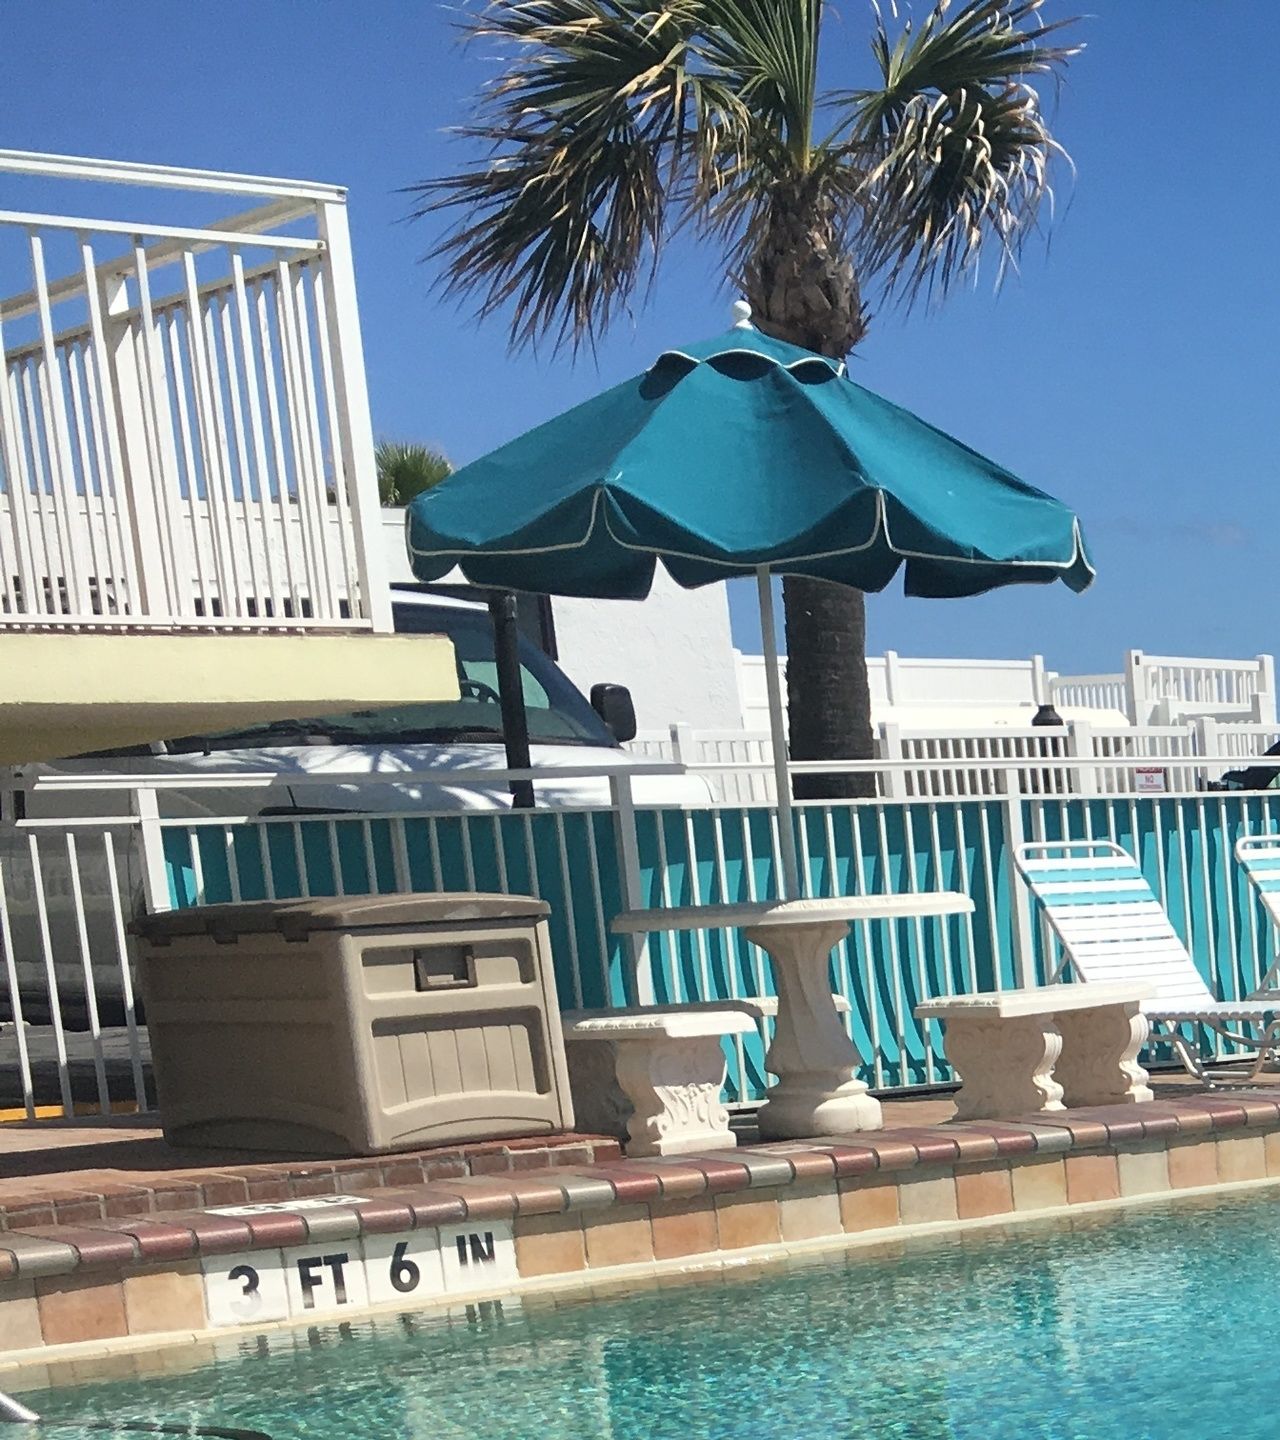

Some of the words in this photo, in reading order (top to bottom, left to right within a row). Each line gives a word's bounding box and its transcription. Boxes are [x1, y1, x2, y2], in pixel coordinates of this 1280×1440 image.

[228, 1265, 261, 1316] 3
[297, 1253, 349, 1309] FT
[390, 1241, 420, 1293] 6
[456, 1231, 496, 1268] IN
